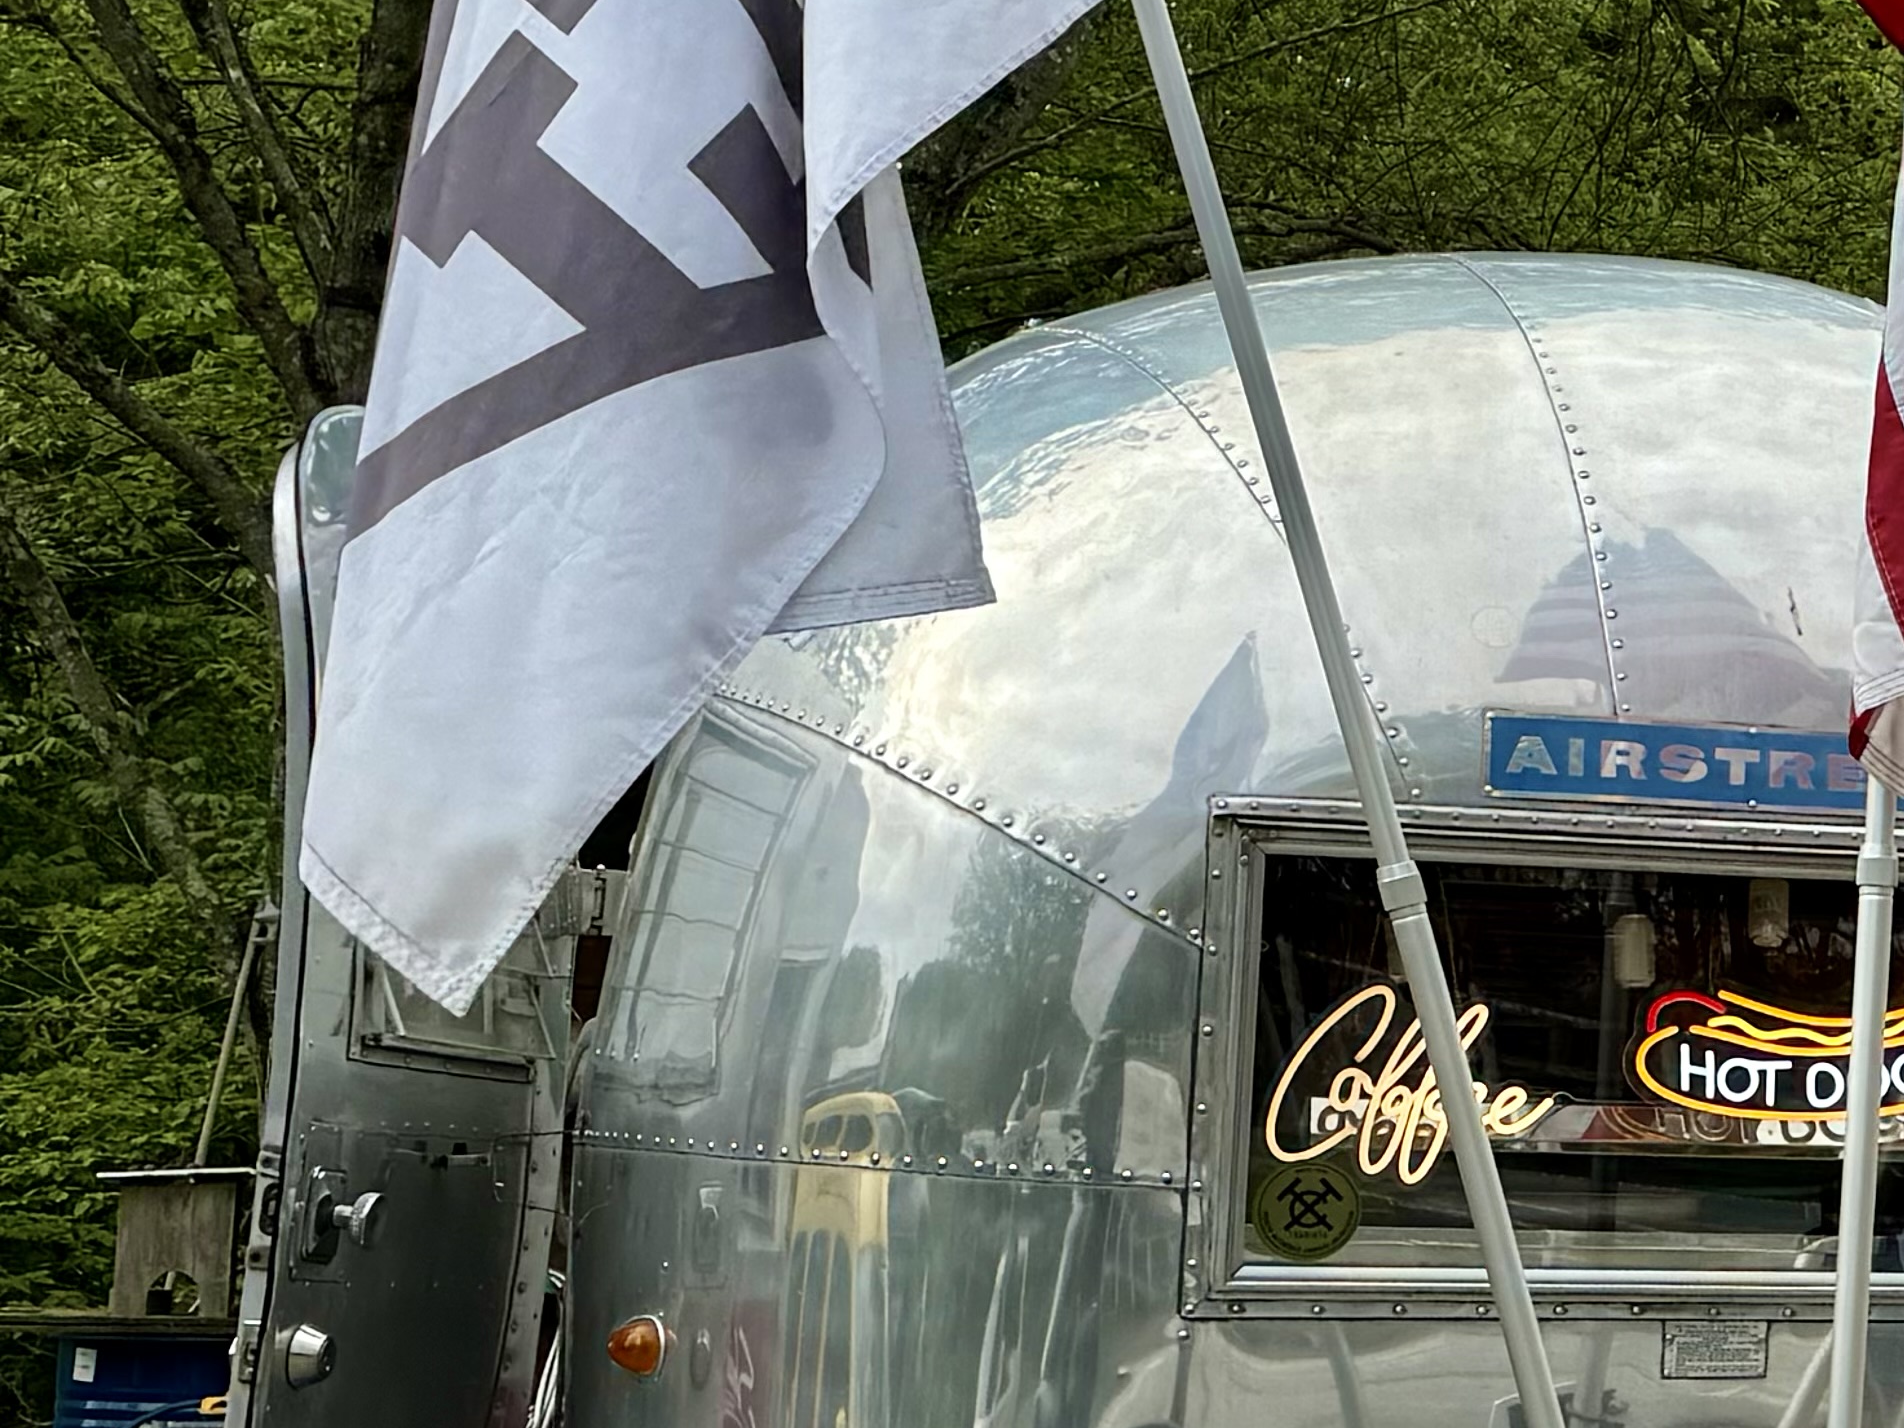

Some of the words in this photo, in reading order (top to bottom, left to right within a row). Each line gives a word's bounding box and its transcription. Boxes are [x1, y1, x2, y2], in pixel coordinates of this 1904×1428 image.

[1505, 734, 1866, 793] AIRSTRE
[1266, 984, 1554, 1185] Coffe
[1679, 1042, 1792, 1106] HOT
